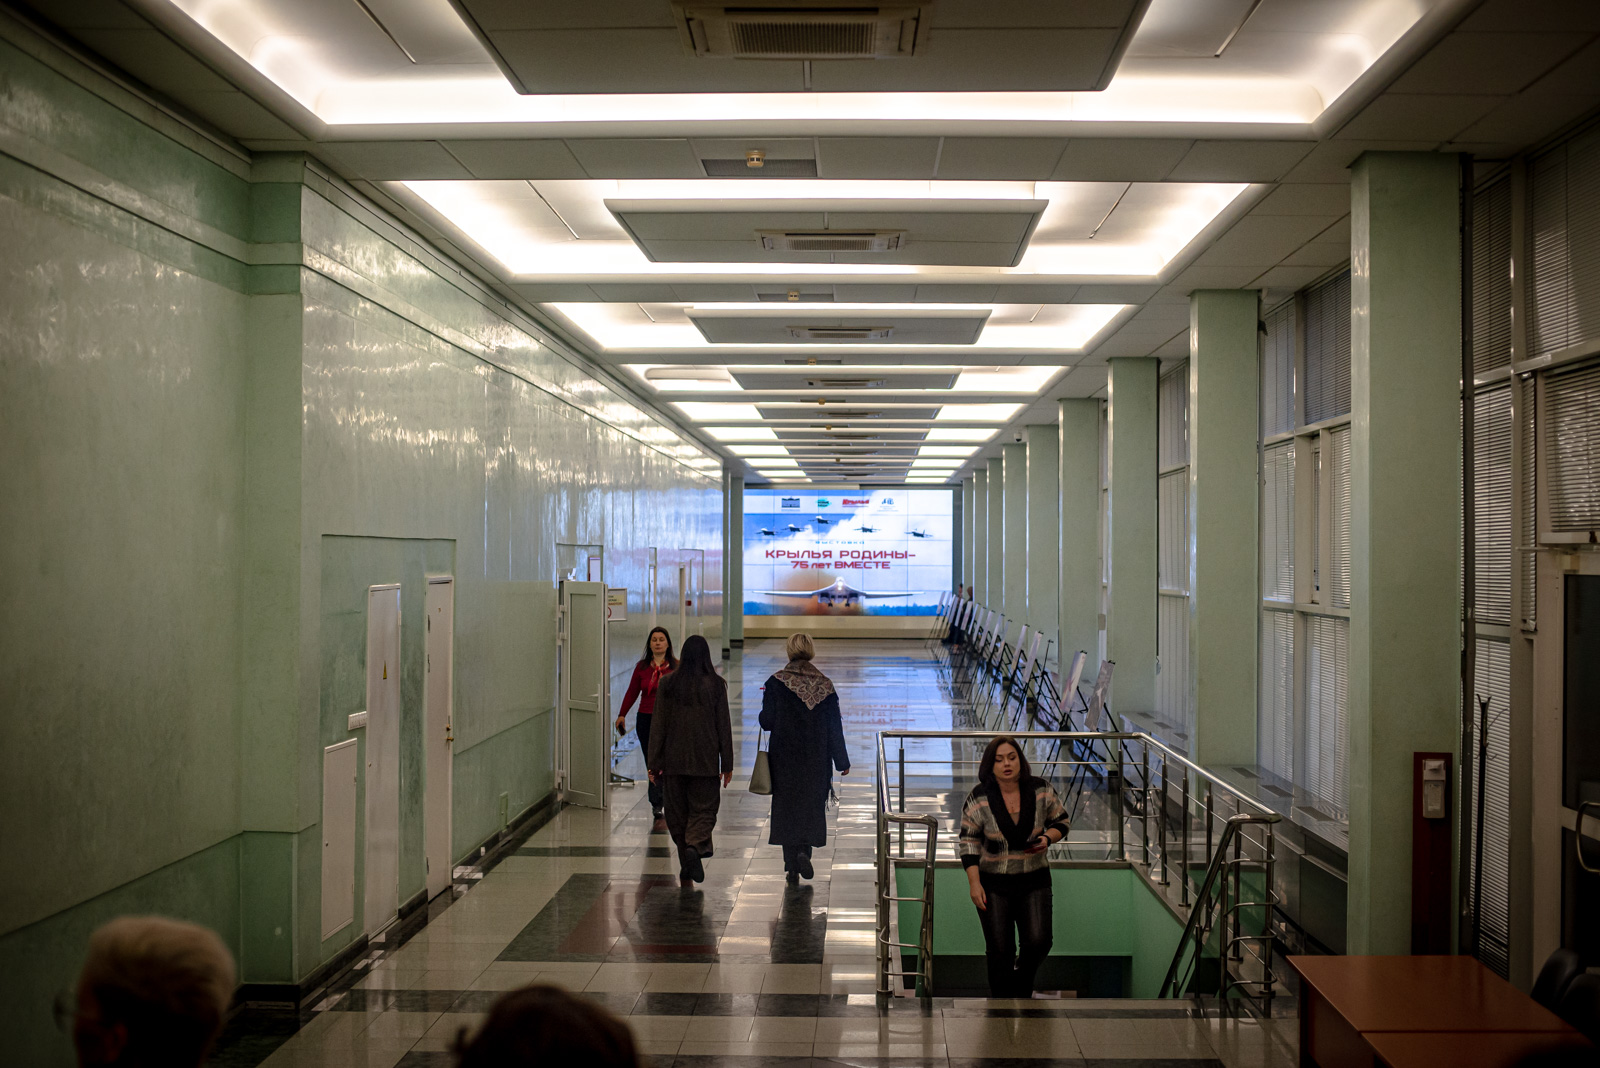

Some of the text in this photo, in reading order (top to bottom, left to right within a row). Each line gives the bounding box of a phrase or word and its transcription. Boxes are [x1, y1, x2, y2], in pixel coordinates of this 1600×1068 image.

[765, 550, 832, 559] КРЫЛЬЯ
[791, 561, 809, 569] 75
[834, 561, 891, 569] ВМЕСТЕ
